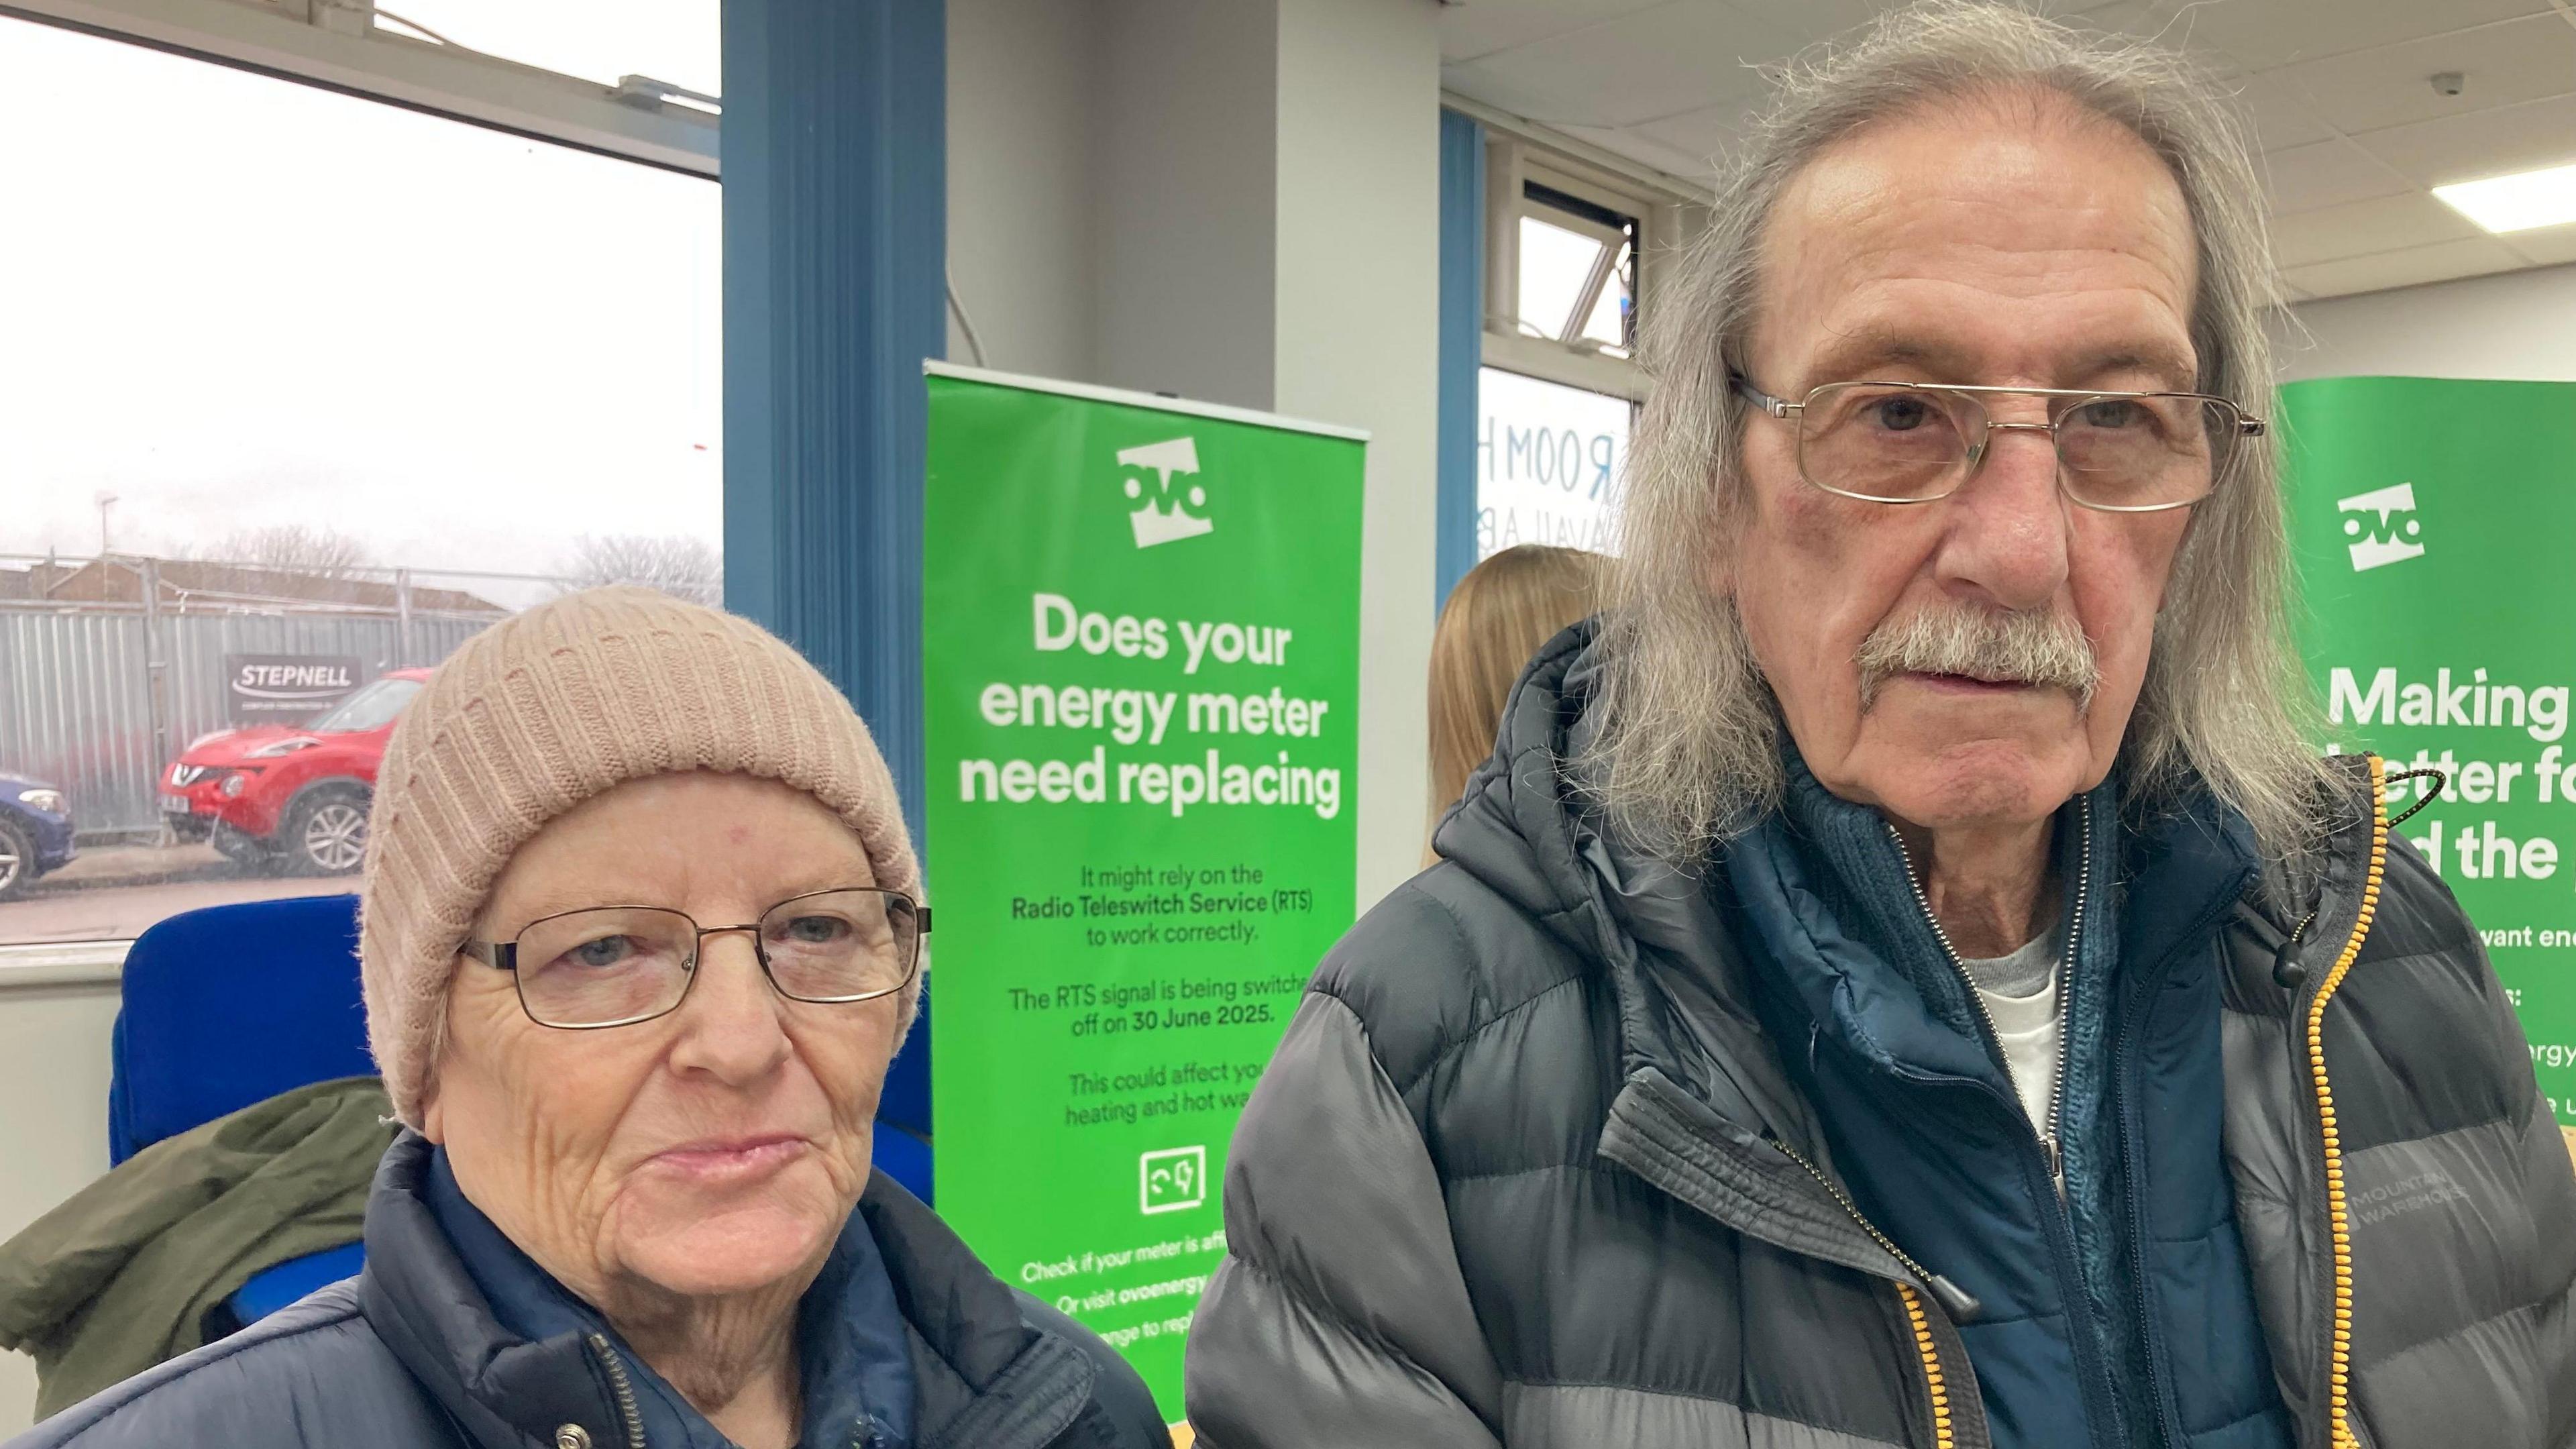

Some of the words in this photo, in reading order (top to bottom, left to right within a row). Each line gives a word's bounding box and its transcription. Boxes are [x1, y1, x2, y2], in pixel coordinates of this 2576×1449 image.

[1033, 592, 1169, 659] Does
[1178, 620, 1292, 674] your
[241, 664, 352, 687] STEPNELL
[979, 682, 1178, 745] energy
[1187, 686, 1329, 737] meter
[2328, 667, 2569, 743] Making
[959, 745, 1106, 803] need
[1118, 749, 1340, 820] replacing
[2326, 743, 2522, 804] etter
[2455, 820, 2558, 879] the
[1080, 866, 1095, 887] It
[1099, 865, 1154, 892] might
[1159, 863, 1195, 890] rely
[1199, 867, 1226, 885] on
[1232, 863, 1263, 885] the
[1012, 896, 1074, 920] Radio
[1079, 893, 1184, 917] Teleswitch
[1189, 891, 1267, 914] Service
[1272, 888, 1313, 914] (RTS)
[1086, 928, 1106, 947] to
[1110, 924, 1159, 945] work
[1163, 920, 1258, 945] correctly.
[1009, 987, 1050, 1010] The
[1057, 983, 1096, 1008] RTS
[1102, 980, 1156, 1009] signal
[1161, 979, 1175, 1000] is
[1181, 975, 1236, 1002] being
[1072, 1013, 1099, 1037] off
[1104, 1015, 1127, 1034] on
[1132, 1010, 1158, 1032] 30
[1163, 1007, 1210, 1028] June
[1217, 1004, 1275, 1026] 2025.
[1068, 1073, 1109, 1097] This
[1113, 1065, 1167, 1091] could
[1171, 1059, 1229, 1085] affect
[1064, 1101, 1137, 1126] heating
[1142, 1091, 1179, 1117] and
[1183, 1090, 1215, 1111] hot
[1021, 1254, 1079, 1283] Check
[1081, 1250, 1094, 1272] if
[1096, 1250, 1134, 1274] your
[1135, 1241, 1182, 1262] meter
[1185, 1234, 1199, 1252] is
[1056, 1295, 1079, 1315] Or
[1083, 1289, 1116, 1310] visit
[1141, 1321, 1161, 1337] to
